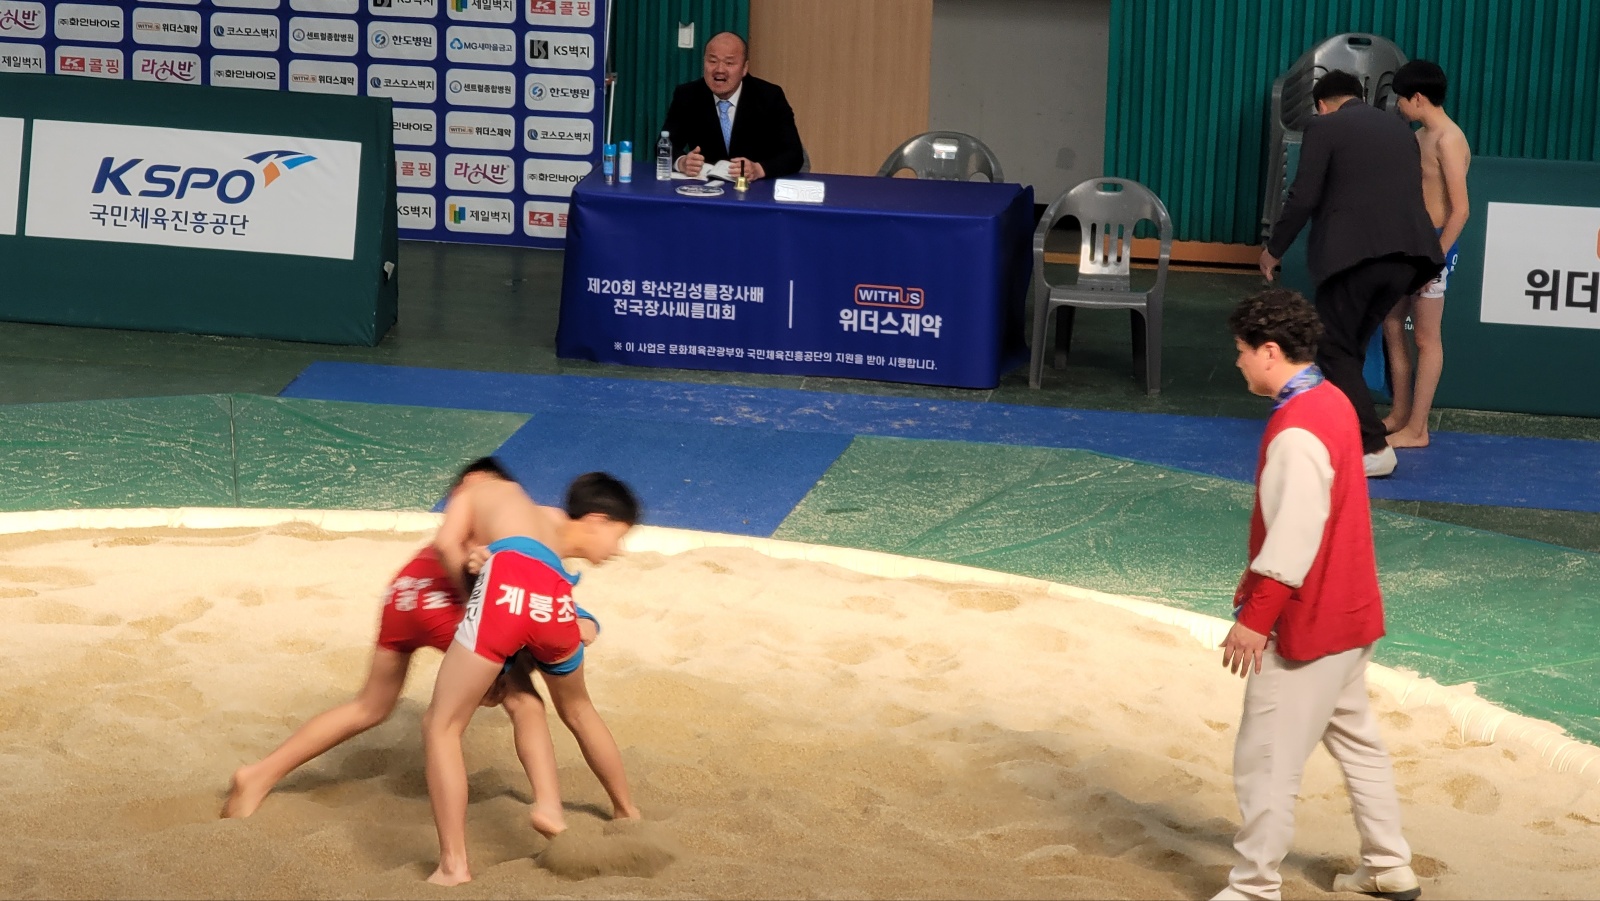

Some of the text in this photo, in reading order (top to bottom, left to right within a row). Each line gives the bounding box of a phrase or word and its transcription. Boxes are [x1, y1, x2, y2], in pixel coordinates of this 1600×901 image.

[559, 1, 590, 16] 콜핑
[0, 9, 40, 30] 쉬반
[162, 23, 198, 34] 위더스제약
[226, 26, 278, 39] 코스모스벽지
[306, 31, 354, 42] 센트럴종합병원
[392, 35, 432, 47] 한도병원
[463, 41, 513, 51] MG새마을금고
[553, 45, 590, 58] KS벽지
[1, 56, 42, 68] 제일벽지
[89, 58, 119, 73] 콜핑
[318, 75, 355, 86] 위더스제약
[383, 78, 435, 90] 코스모스벽지
[464, 83, 512, 94] 센트럴종합병원
[549, 87, 590, 99] 한도병원
[475, 126, 512, 138] 위더스제약
[540, 130, 591, 142] 코스모스벽지
[401, 161, 431, 177] 콜핑
[91, 157, 255, 204] KSPO
[90, 203, 249, 236] 국민체육진흥공단
[470, 210, 511, 223] 제일벽지
[587, 277, 764, 303] 제20회 학산김성률장사배
[857, 287, 922, 306] WITHUS
[613, 298, 736, 321] 전국장사씨름대회
[839, 308, 942, 338] 위더스제약
[625, 342, 635, 353] 이
[638, 343, 666, 355] 사업은
[669, 344, 744, 359] 문화체육관광부와
[747, 349, 832, 363] 국민체육진흥공단의
[835, 352, 864, 365] 지원을
[867, 355, 885, 366] 받아
[888, 356, 938, 371] 시행합니다.
[495, 583, 577, 624] 계룡초
